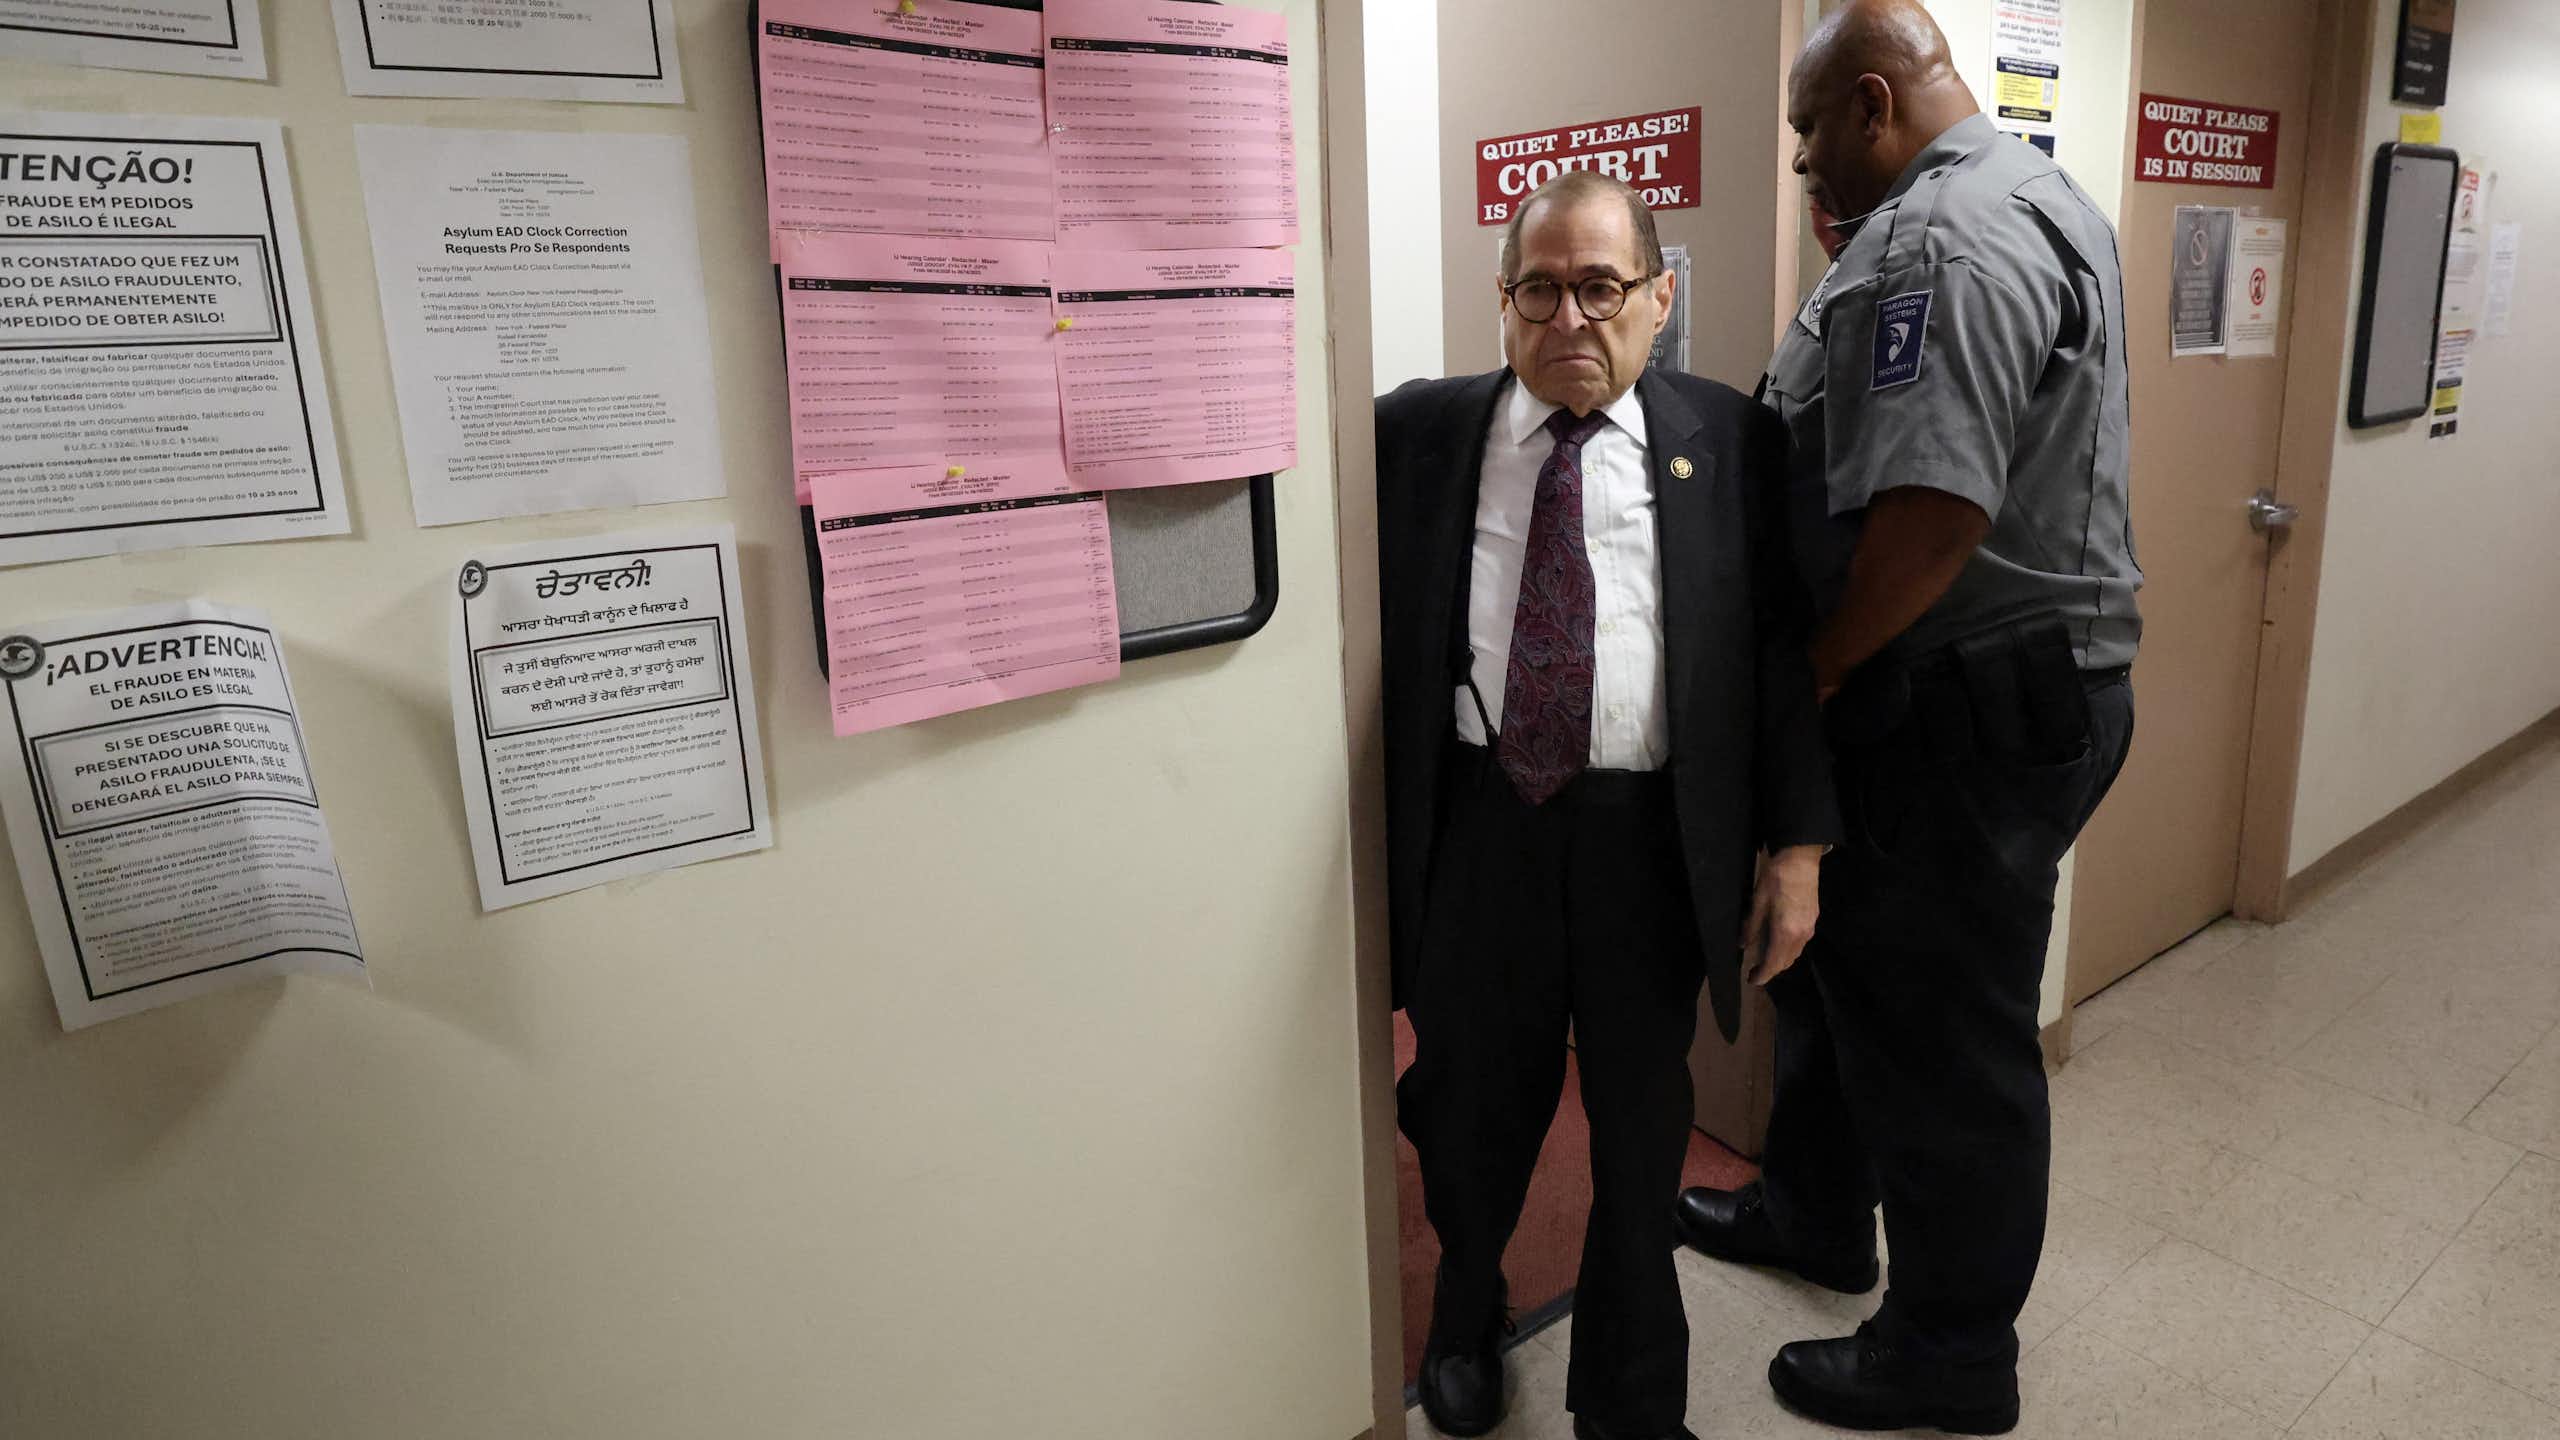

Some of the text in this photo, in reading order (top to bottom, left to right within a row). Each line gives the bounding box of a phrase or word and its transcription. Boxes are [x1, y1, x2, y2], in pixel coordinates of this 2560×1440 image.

[2145, 101, 2268, 132] QUIET PLEASE
[1483, 114, 1689, 160] QUIET PLEASE!
[2164, 128, 2248, 159] COURT
[2144, 158, 2262, 182] IS IN SESSION
[79, 196, 106, 208] EM
[112, 197, 194, 210] PEDIDOS
[1484, 203, 1508, 220] IS
[6, 213, 176, 228] DE ASILO É ILEGAL
[444, 226, 627, 239] Asylum EAD Clock Correction
[445, 242, 630, 255] Requests Pro Se Respondents
[18, 256, 136, 268] CONSTATADO
[140, 256, 177, 270] QUE
[181, 256, 210, 267] FEZ
[213, 255, 240, 267] UM
[31, 276, 55, 288] DE
[59, 276, 110, 288] ASILO
[115, 274, 242, 288] FRAUDULENTO,
[0, 293, 217, 308] ERÁ PERMANENTEMENTE
[1882, 298, 1923, 312] PARAGON
[86, 314, 110, 326] DE
[114, 313, 170, 326] OBTER
[172, 312, 224, 325] ASILO!
[1884, 308, 1917, 321] SYSTEMS
[1878, 363, 1912, 377] SECURITY
[536, 558, 652, 598] ਚੇਤਾਵਨੀ!
[46, 634, 267, 686] ¡ADVERTENCIA!
[89, 666, 257, 696] EL FRAUDE EN MATERIA
[110, 683, 254, 711] DE ASILO ES ILEGAL
[105, 722, 271, 752] SI SE DESCUBRE QUE HA
[75, 738, 290, 776] PRESENTADO UNA SOLICITUD DE
[99, 754, 287, 790] ASILO FRAUDULENTA, ¡SE LE
[72, 771, 304, 814] DENEGARÁ EL ASILO PARA SIEMPRE!
